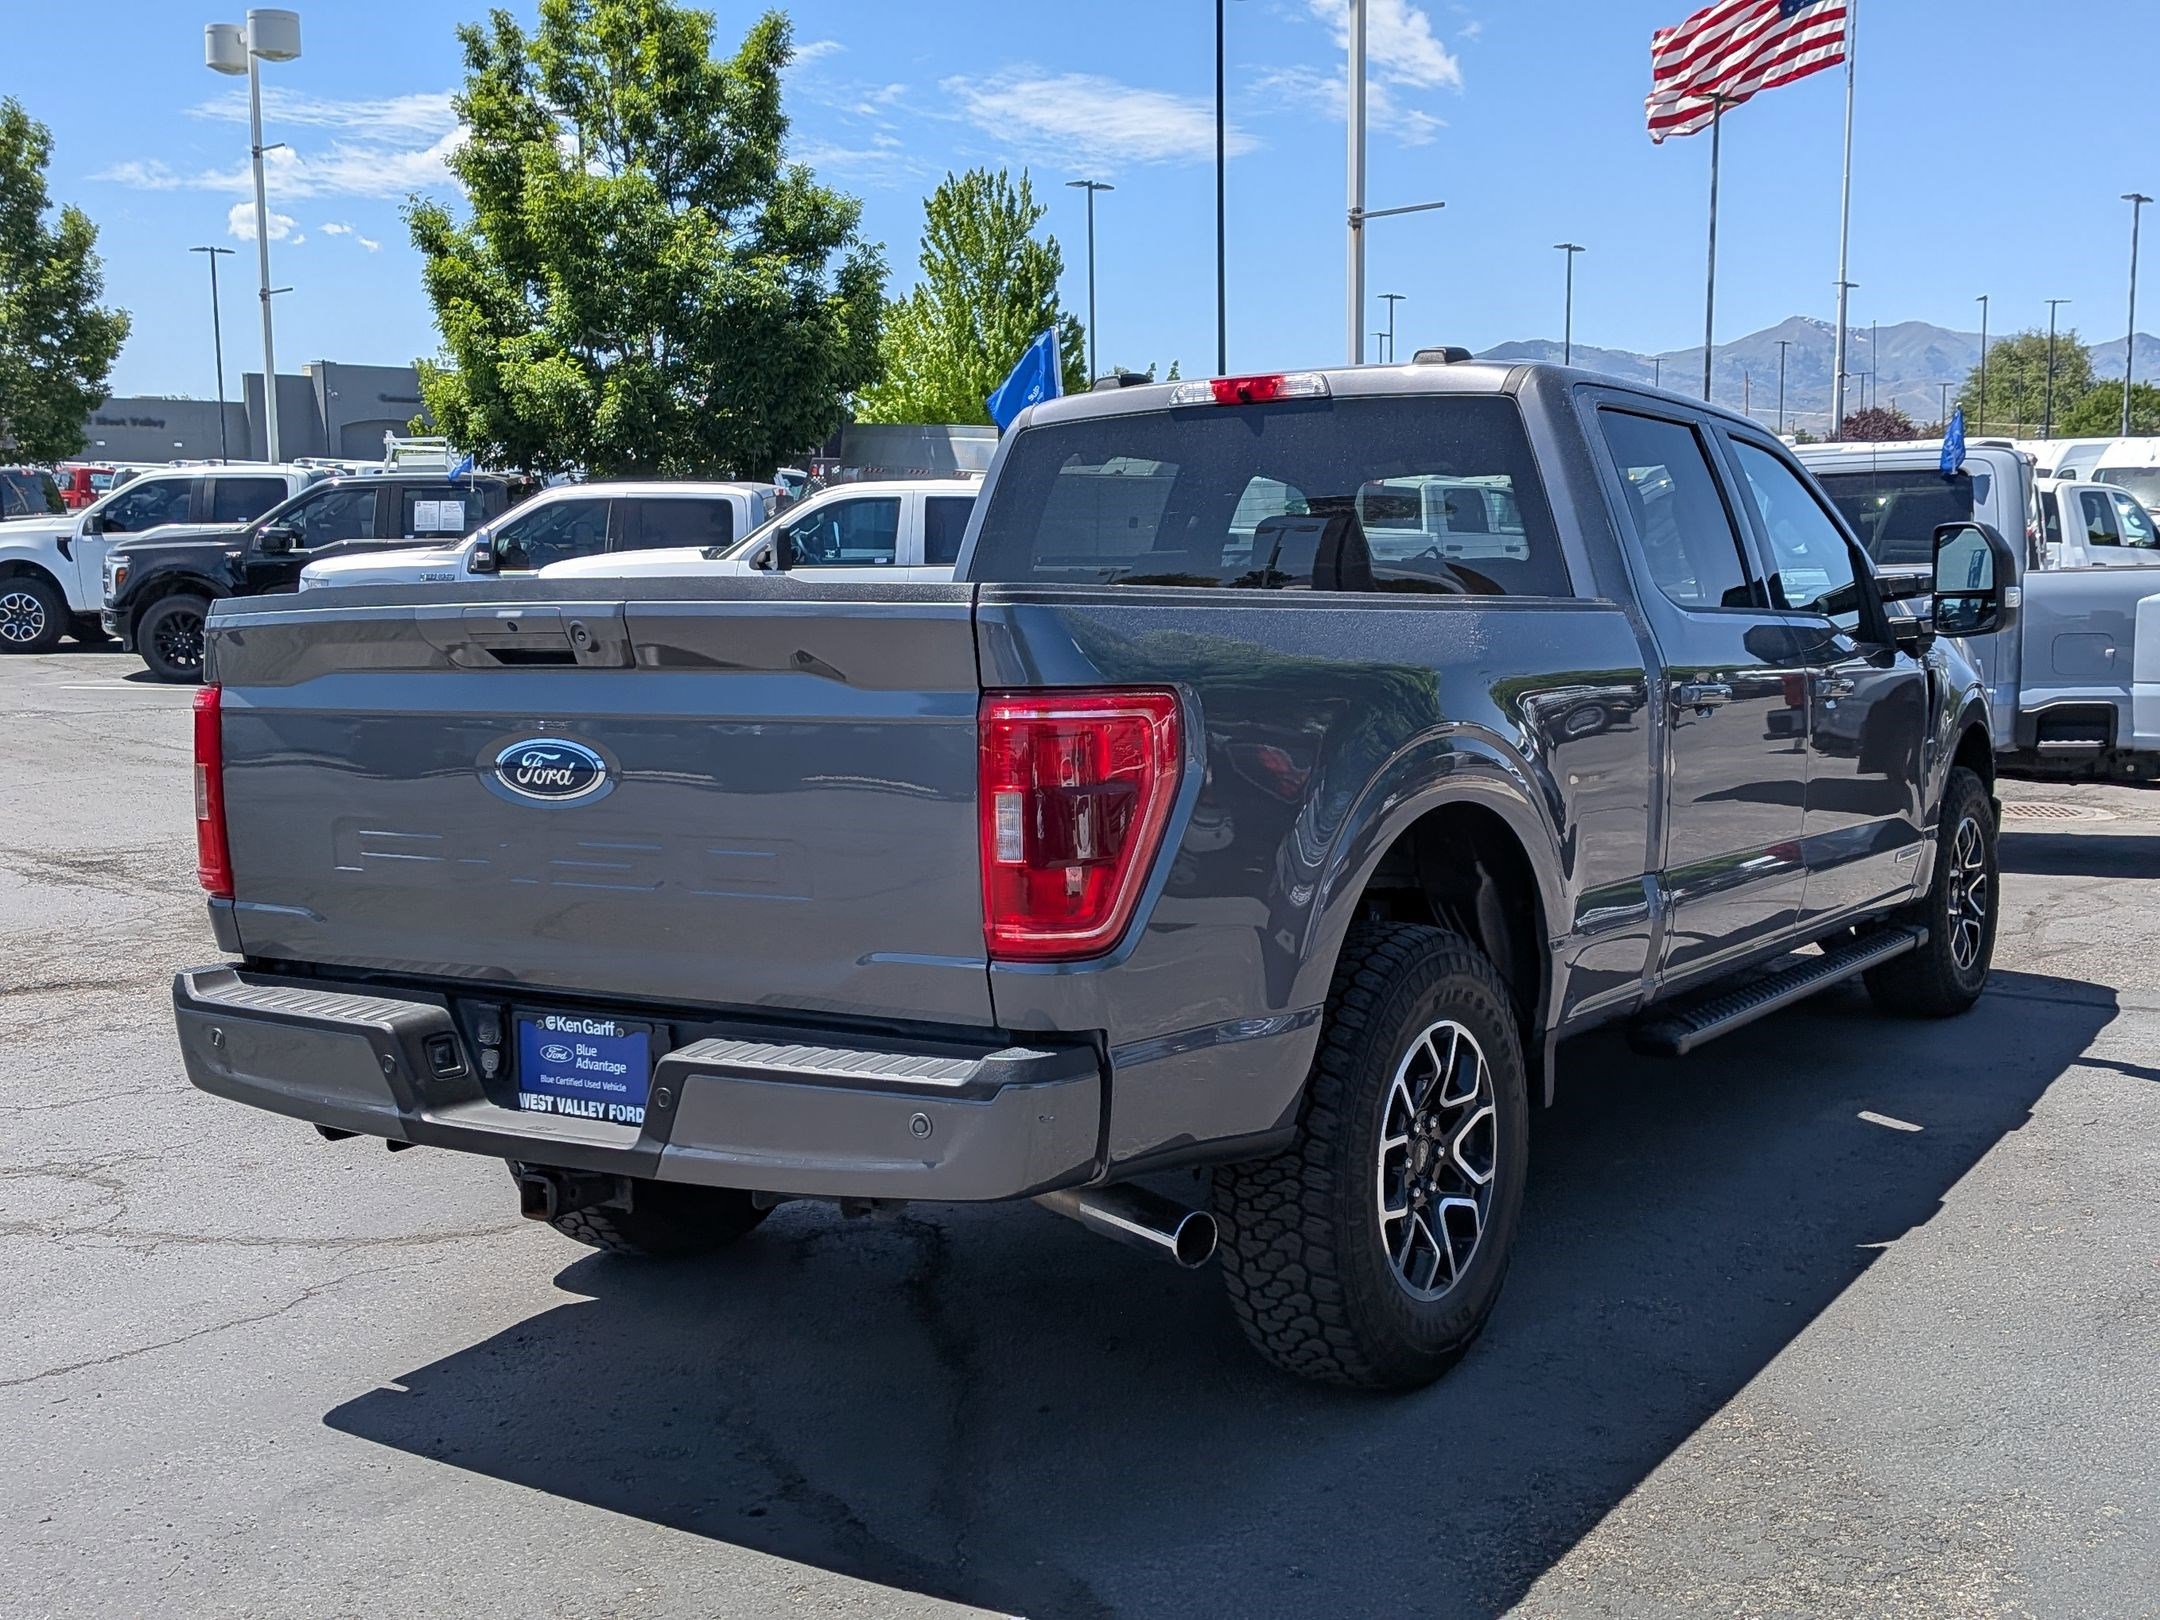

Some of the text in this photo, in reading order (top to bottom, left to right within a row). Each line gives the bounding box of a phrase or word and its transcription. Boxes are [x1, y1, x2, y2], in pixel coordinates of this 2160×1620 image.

[517, 751, 576, 786] Ford
[557, 1016, 615, 1036] Ken Garff
[546, 1047, 567, 1060] Ford
[576, 1043, 597, 1056] Blue
[576, 1058, 627, 1075] Advantage
[540, 1074, 627, 1093] Blue Certified Used Vehicle
[519, 1092, 645, 1123] WEST VALLEY FORD
